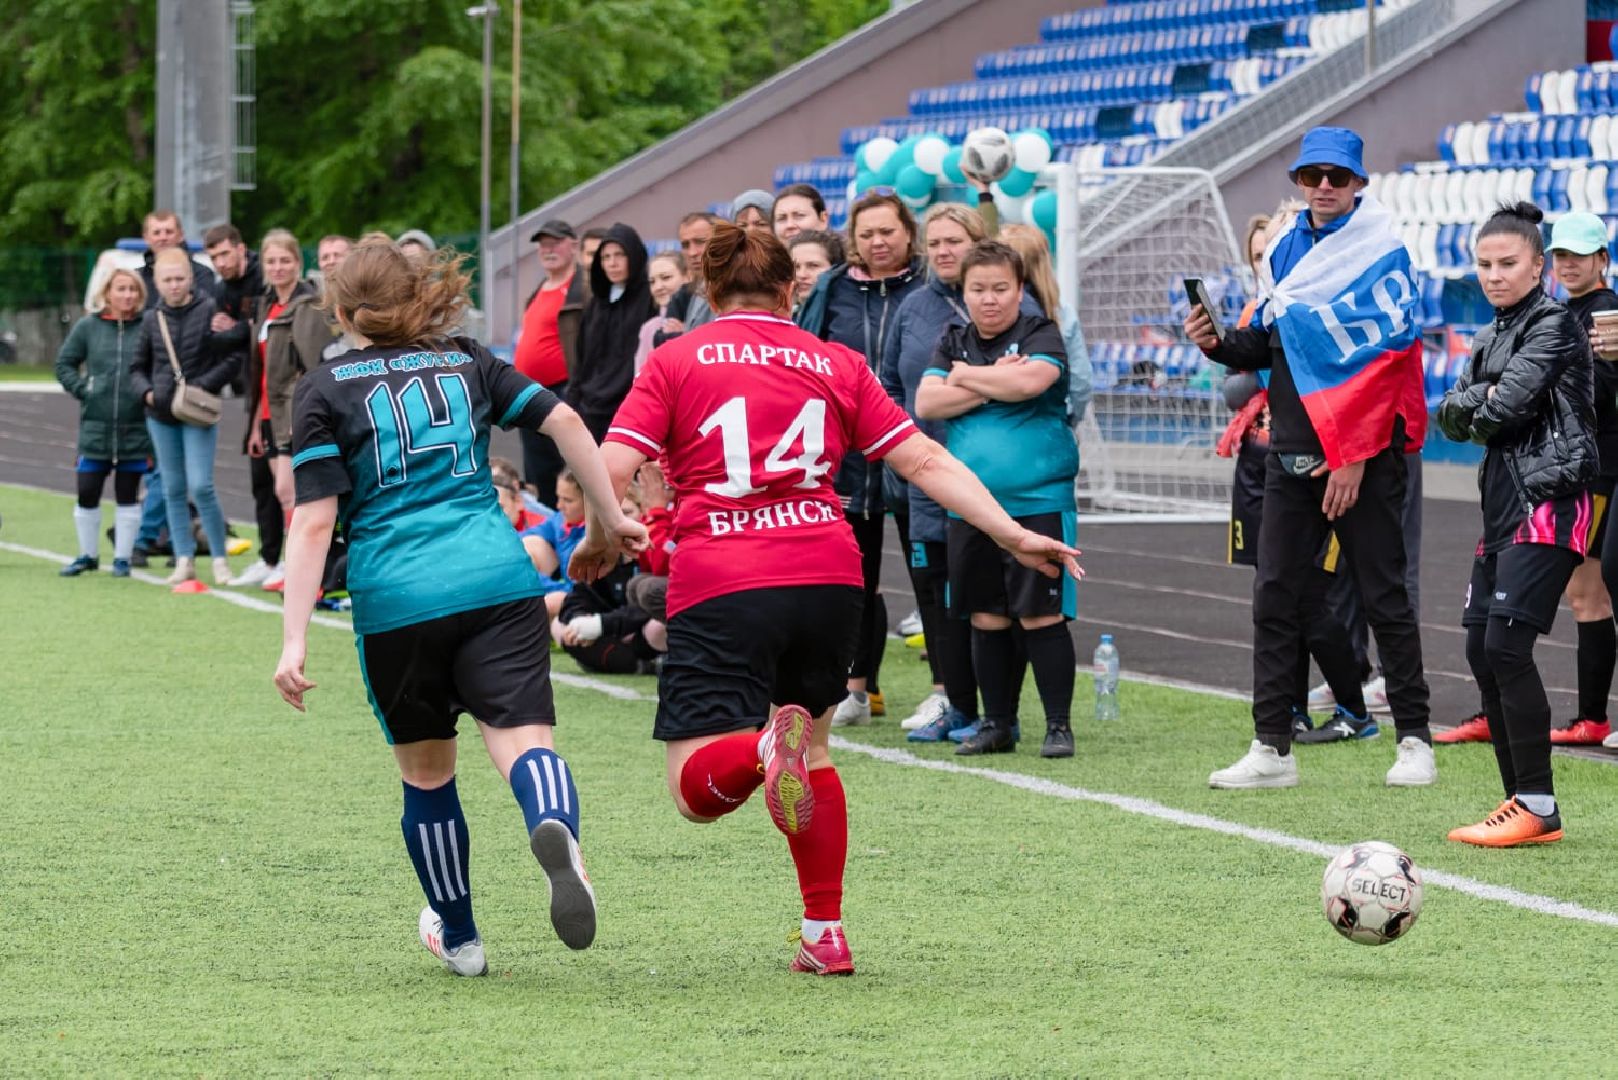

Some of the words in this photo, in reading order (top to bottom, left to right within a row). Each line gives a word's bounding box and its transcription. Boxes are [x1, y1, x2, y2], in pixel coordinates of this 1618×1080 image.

[331, 358, 388, 381] ЖФК
[697, 343, 833, 376] СПАРТАК
[365, 372, 478, 488] 14
[697, 396, 832, 498] 14
[707, 500, 838, 535] БРЯНСК
[1351, 879, 1406, 901] SELECT
